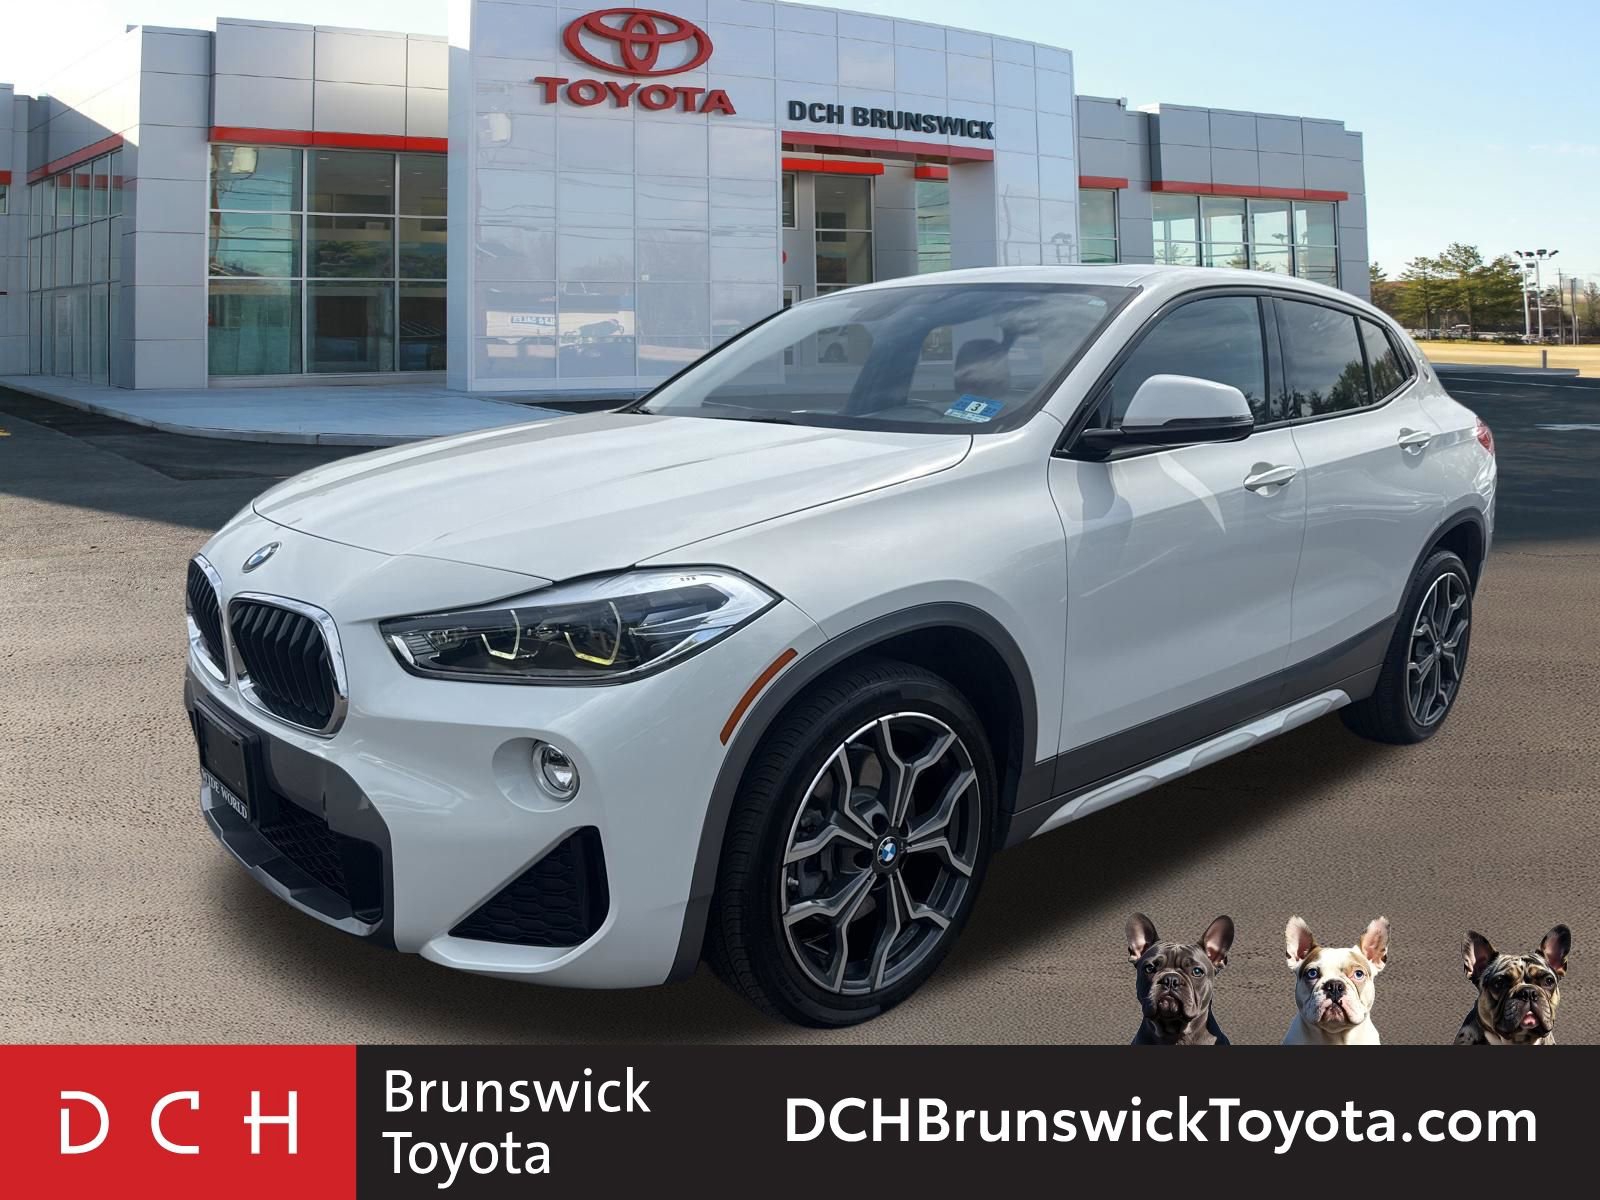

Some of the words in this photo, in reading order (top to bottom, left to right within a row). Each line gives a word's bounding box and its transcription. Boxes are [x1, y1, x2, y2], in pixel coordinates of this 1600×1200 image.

[534, 76, 737, 115] TOYOTA
[788, 100, 845, 125] DCH
[852, 106, 995, 140] BRUNSWICK
[970, 403, 982, 412] 3
[220, 786, 248, 819] WORLD
